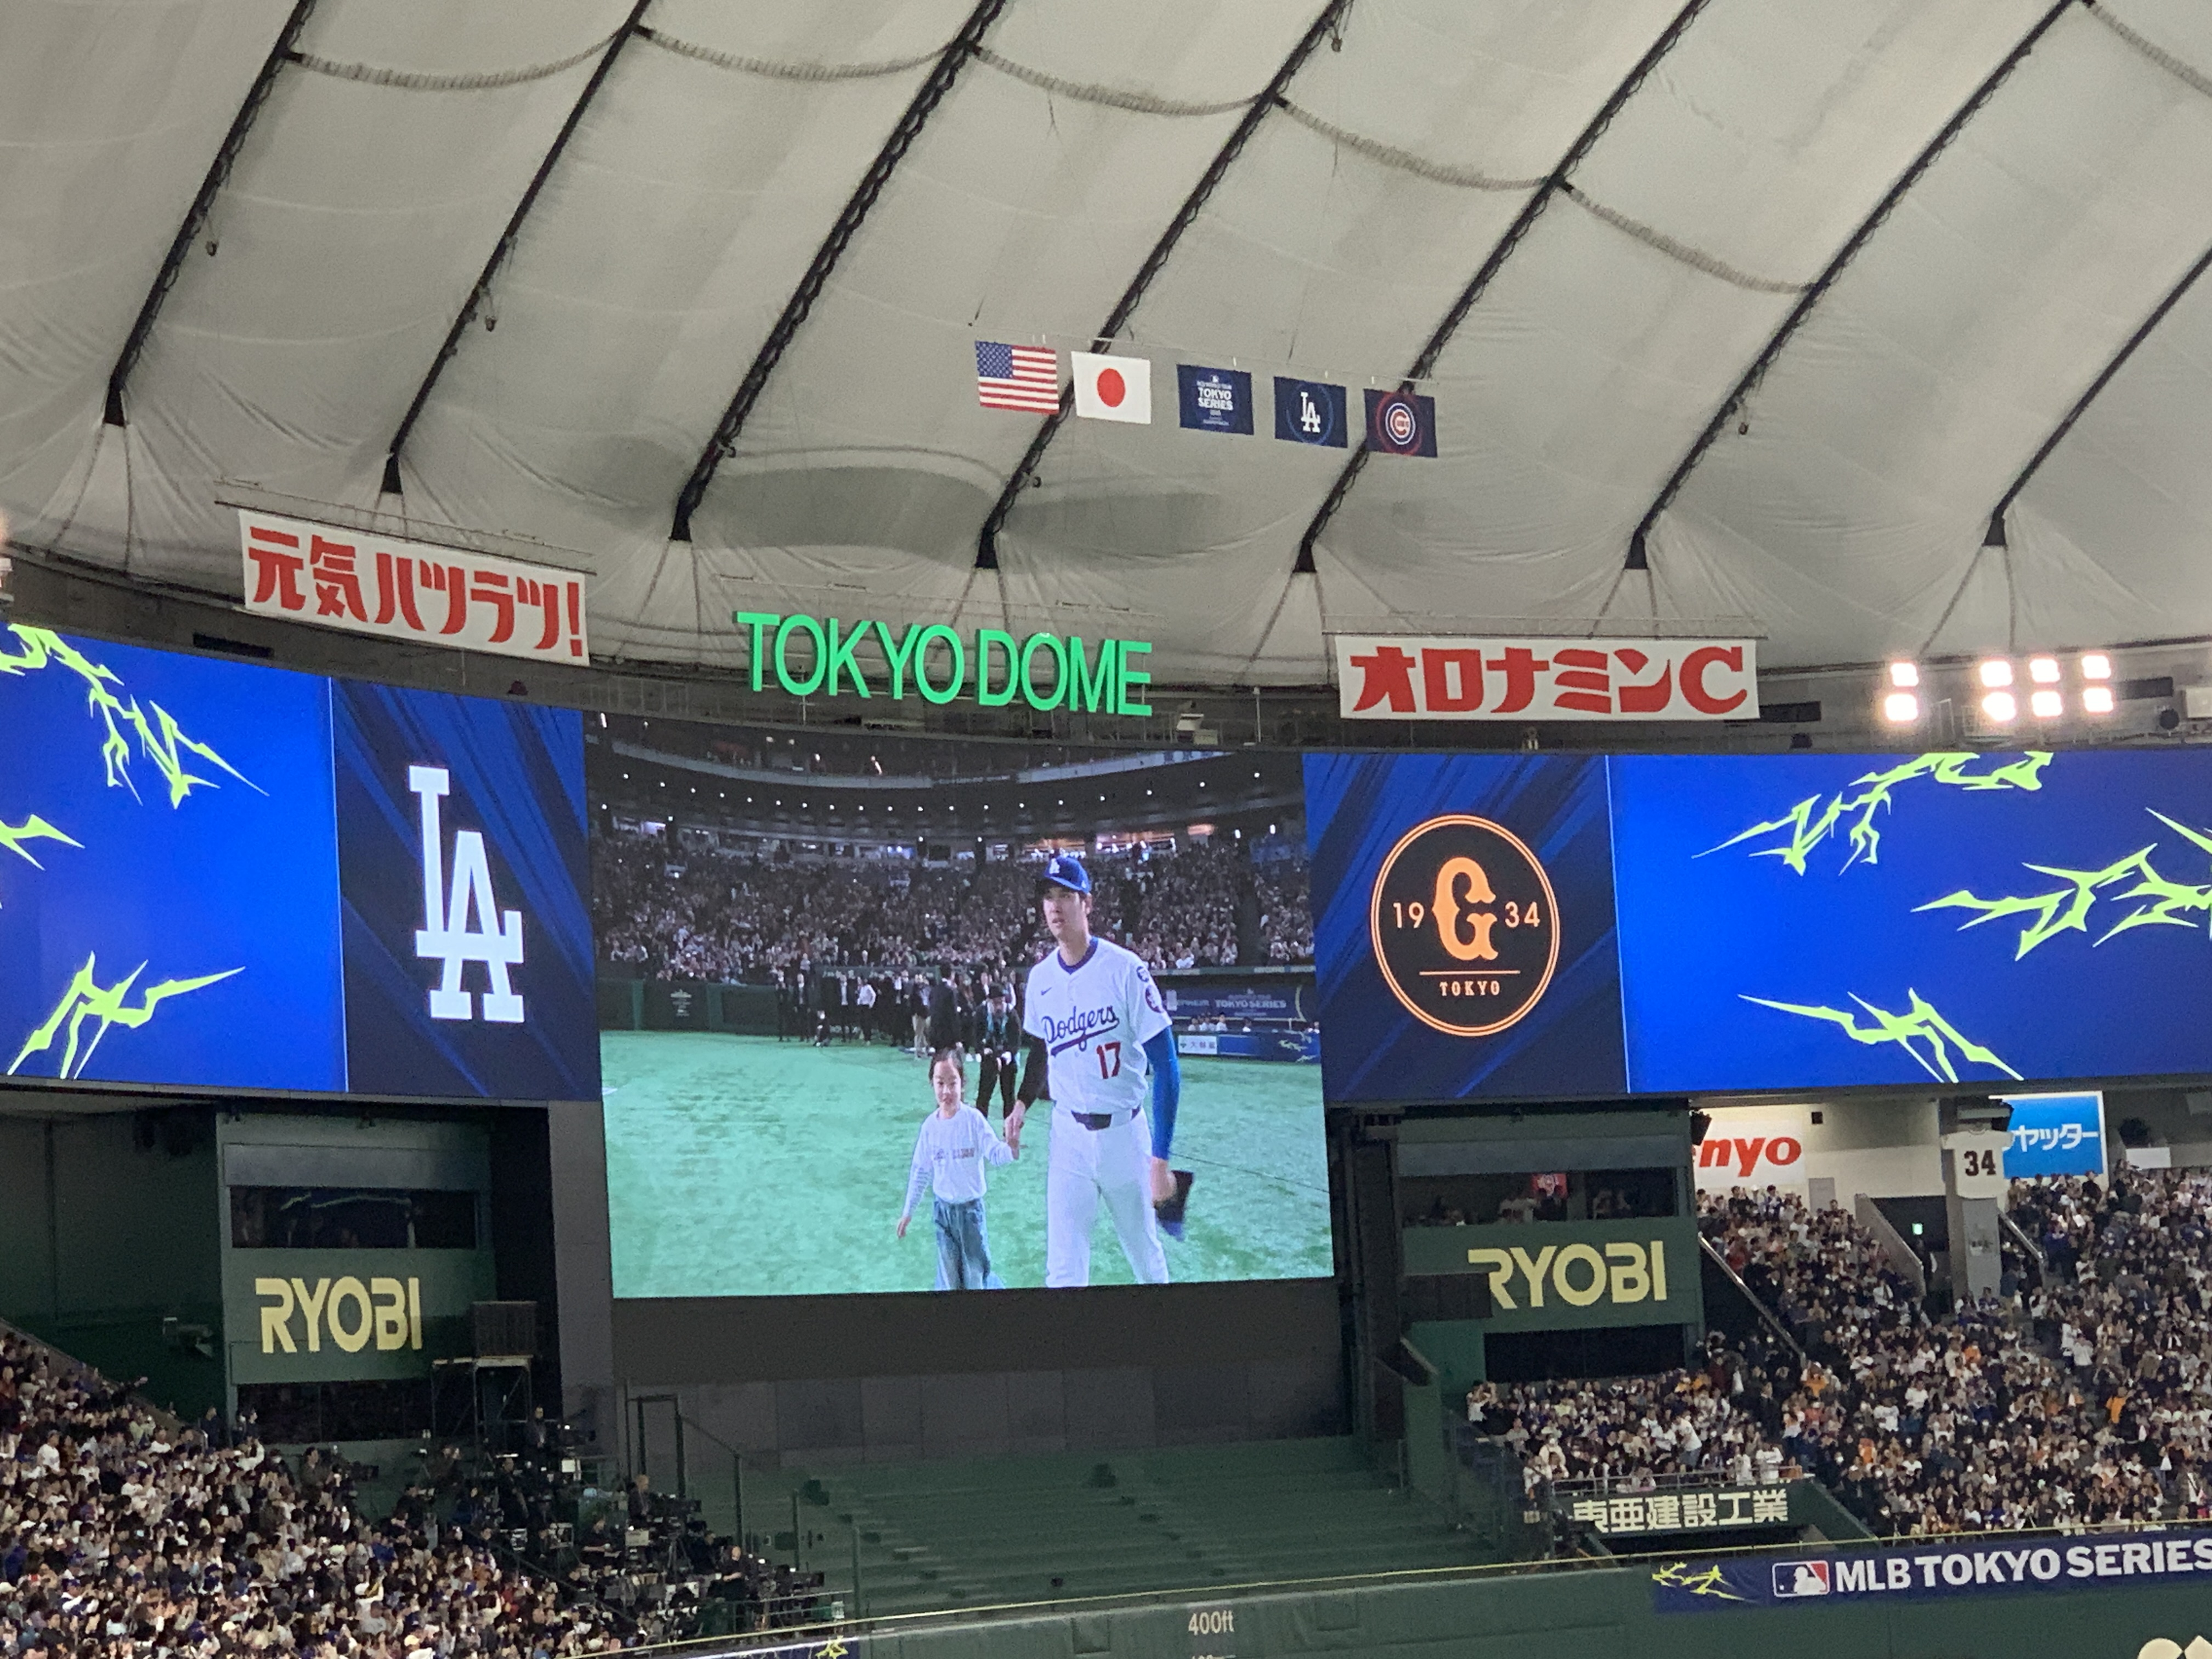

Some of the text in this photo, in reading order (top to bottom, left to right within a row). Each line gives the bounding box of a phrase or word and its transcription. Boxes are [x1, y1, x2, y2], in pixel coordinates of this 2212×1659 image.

[1197, 387, 1232, 400] TOKYO
[1198, 397, 1233, 410] SERIES
[1300, 391, 1321, 433] LA
[248, 526, 583, 657] 元気ハツラツ!
[732, 611, 1152, 717] TOKYO DOME
[1350, 646, 1748, 714] オロナミンC
[408, 765, 524, 1023] LA
[1393, 857, 1541, 960] 19 G 34
[1215, 999, 1248, 1008] TOKYO
[1250, 999, 1287, 1009] SERIES
[1439, 981, 1501, 996] TOKYO
[1041, 1005, 1120, 1053] Dodgers
[1097, 1041, 1121, 1079] 17
[1692, 1137, 1802, 1178] nyo
[2003, 1123, 2099, 1152] ヤッター
[1964, 1150, 1997, 1176] 34
[1467, 1240, 1668, 1310] RYOBI
[255, 1276, 423, 1354] RYOBI
[1835, 1538, 2212, 1592] MLB TOKYO SERIES
[1188, 1610, 1235, 1636] 400ft
